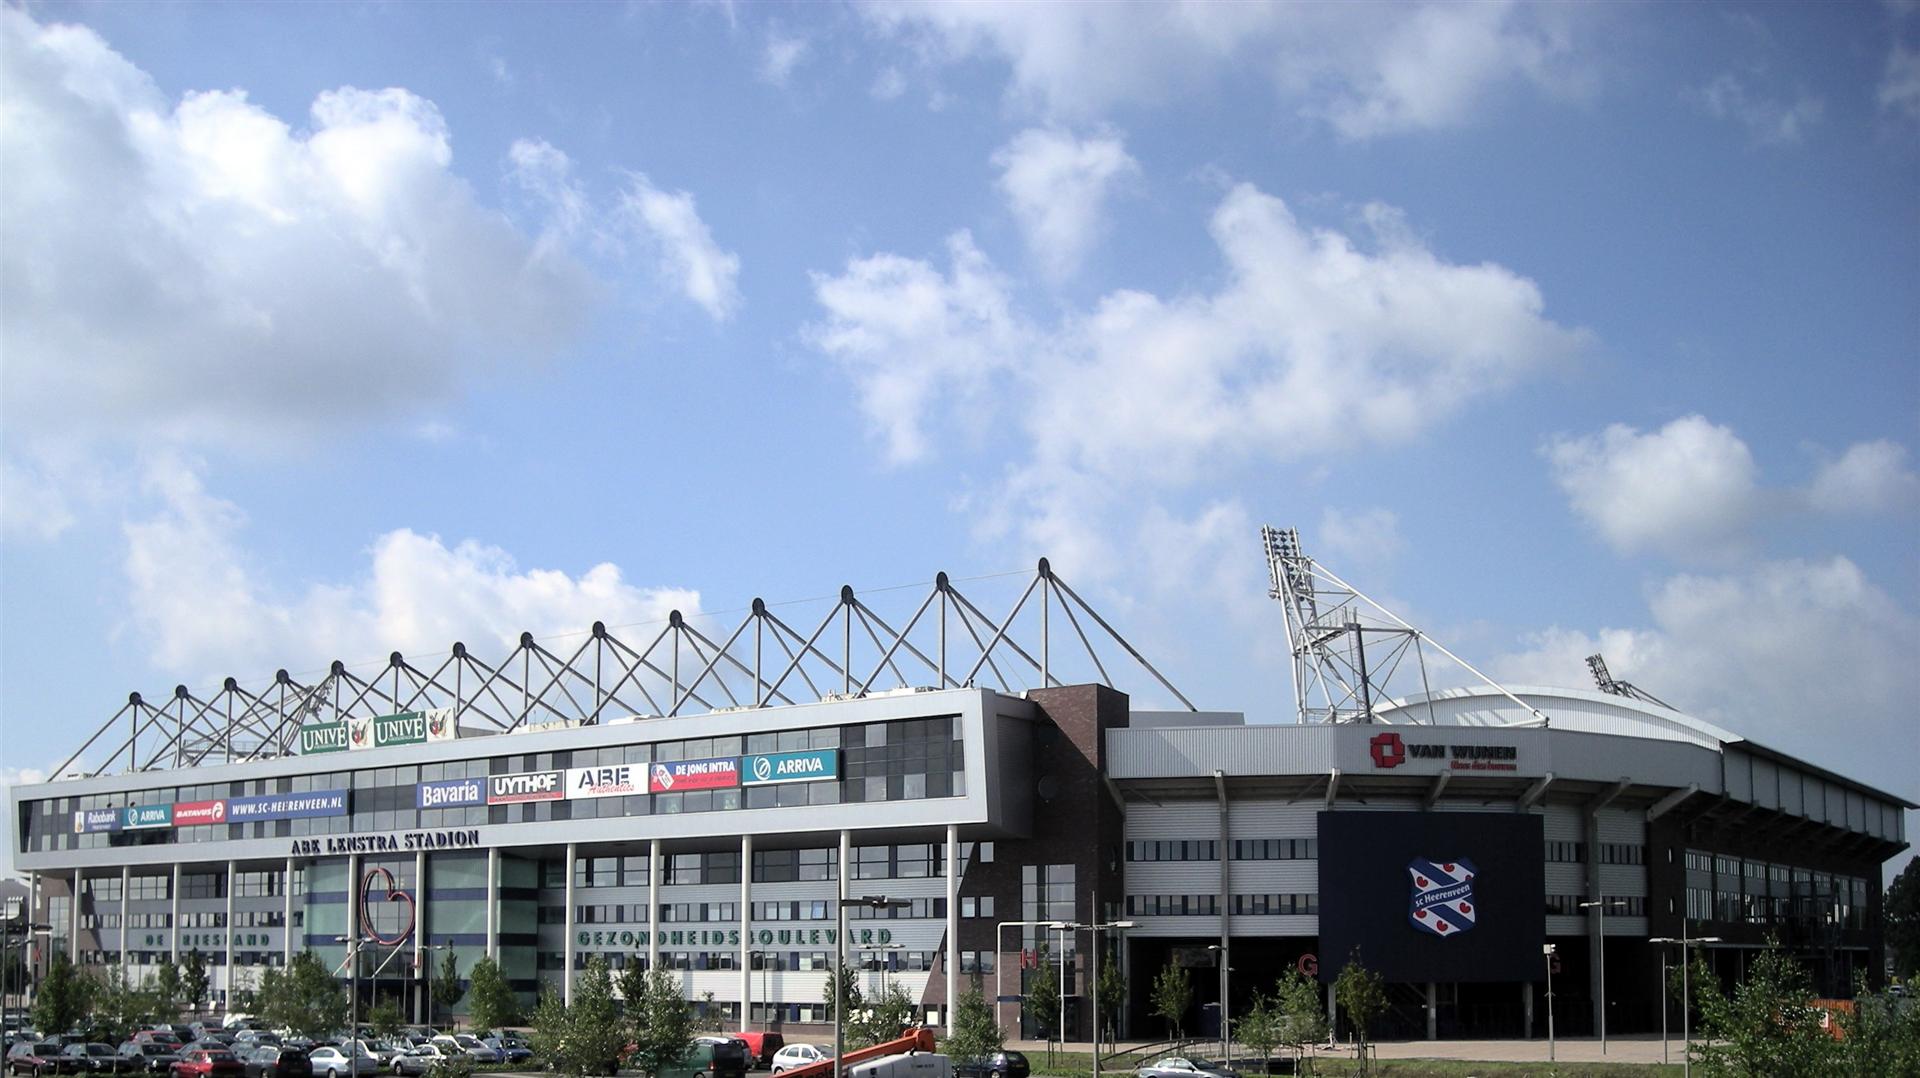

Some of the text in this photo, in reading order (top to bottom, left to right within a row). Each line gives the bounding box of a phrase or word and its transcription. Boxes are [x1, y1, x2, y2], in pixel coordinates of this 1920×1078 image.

[303, 721, 348, 751] UNIVÉ
[376, 712, 424, 743] UNIVÉ
[1407, 744, 1445, 759] VAN
[676, 761, 735, 777] DE JONG INTRA
[777, 757, 823, 774] ARRIVA
[495, 773, 557, 795] UYTHOF
[578, 767, 630, 788] ABE
[422, 782, 479, 806] Bavaria
[88, 810, 116, 824] Rabobank
[140, 809, 165, 822] ARRIVA
[176, 808, 212, 818] BATAVUS
[291, 830, 480, 855] ABE LENSTRA STADION
[1424, 884, 1471, 903] Heerenveen
[145, 934, 270, 946] DE RIESAND
[1021, 948, 1038, 969] H
[1298, 953, 1318, 976] G
